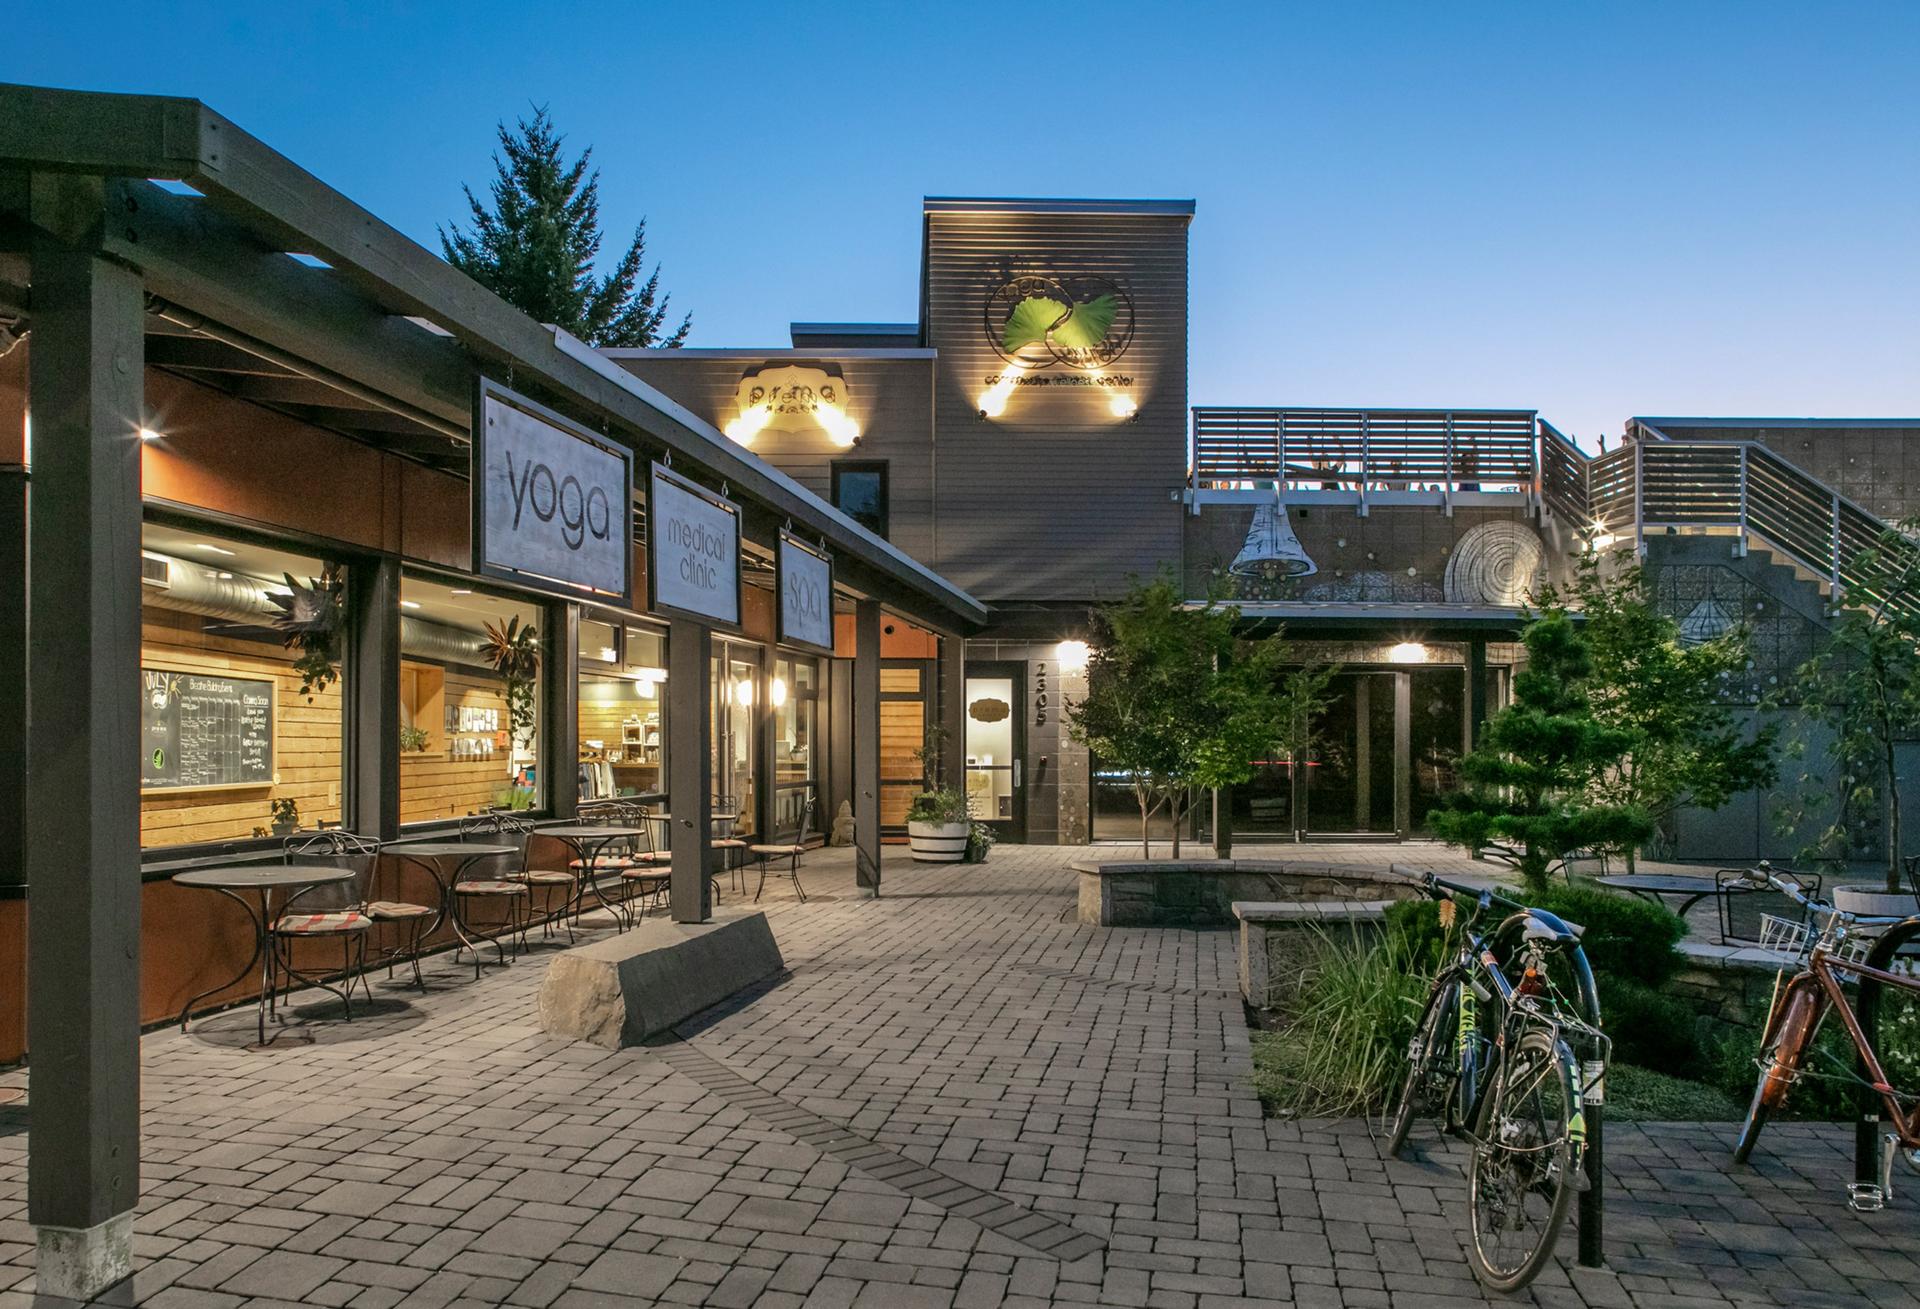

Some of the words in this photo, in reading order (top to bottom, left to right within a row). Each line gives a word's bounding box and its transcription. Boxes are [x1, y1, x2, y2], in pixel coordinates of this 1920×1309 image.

[505, 450, 611, 551] yoga
[668, 516, 726, 562] medical
[679, 556, 717, 591] clinic
[789, 570, 823, 626] spa
[1036, 662, 1049, 727] 2305
